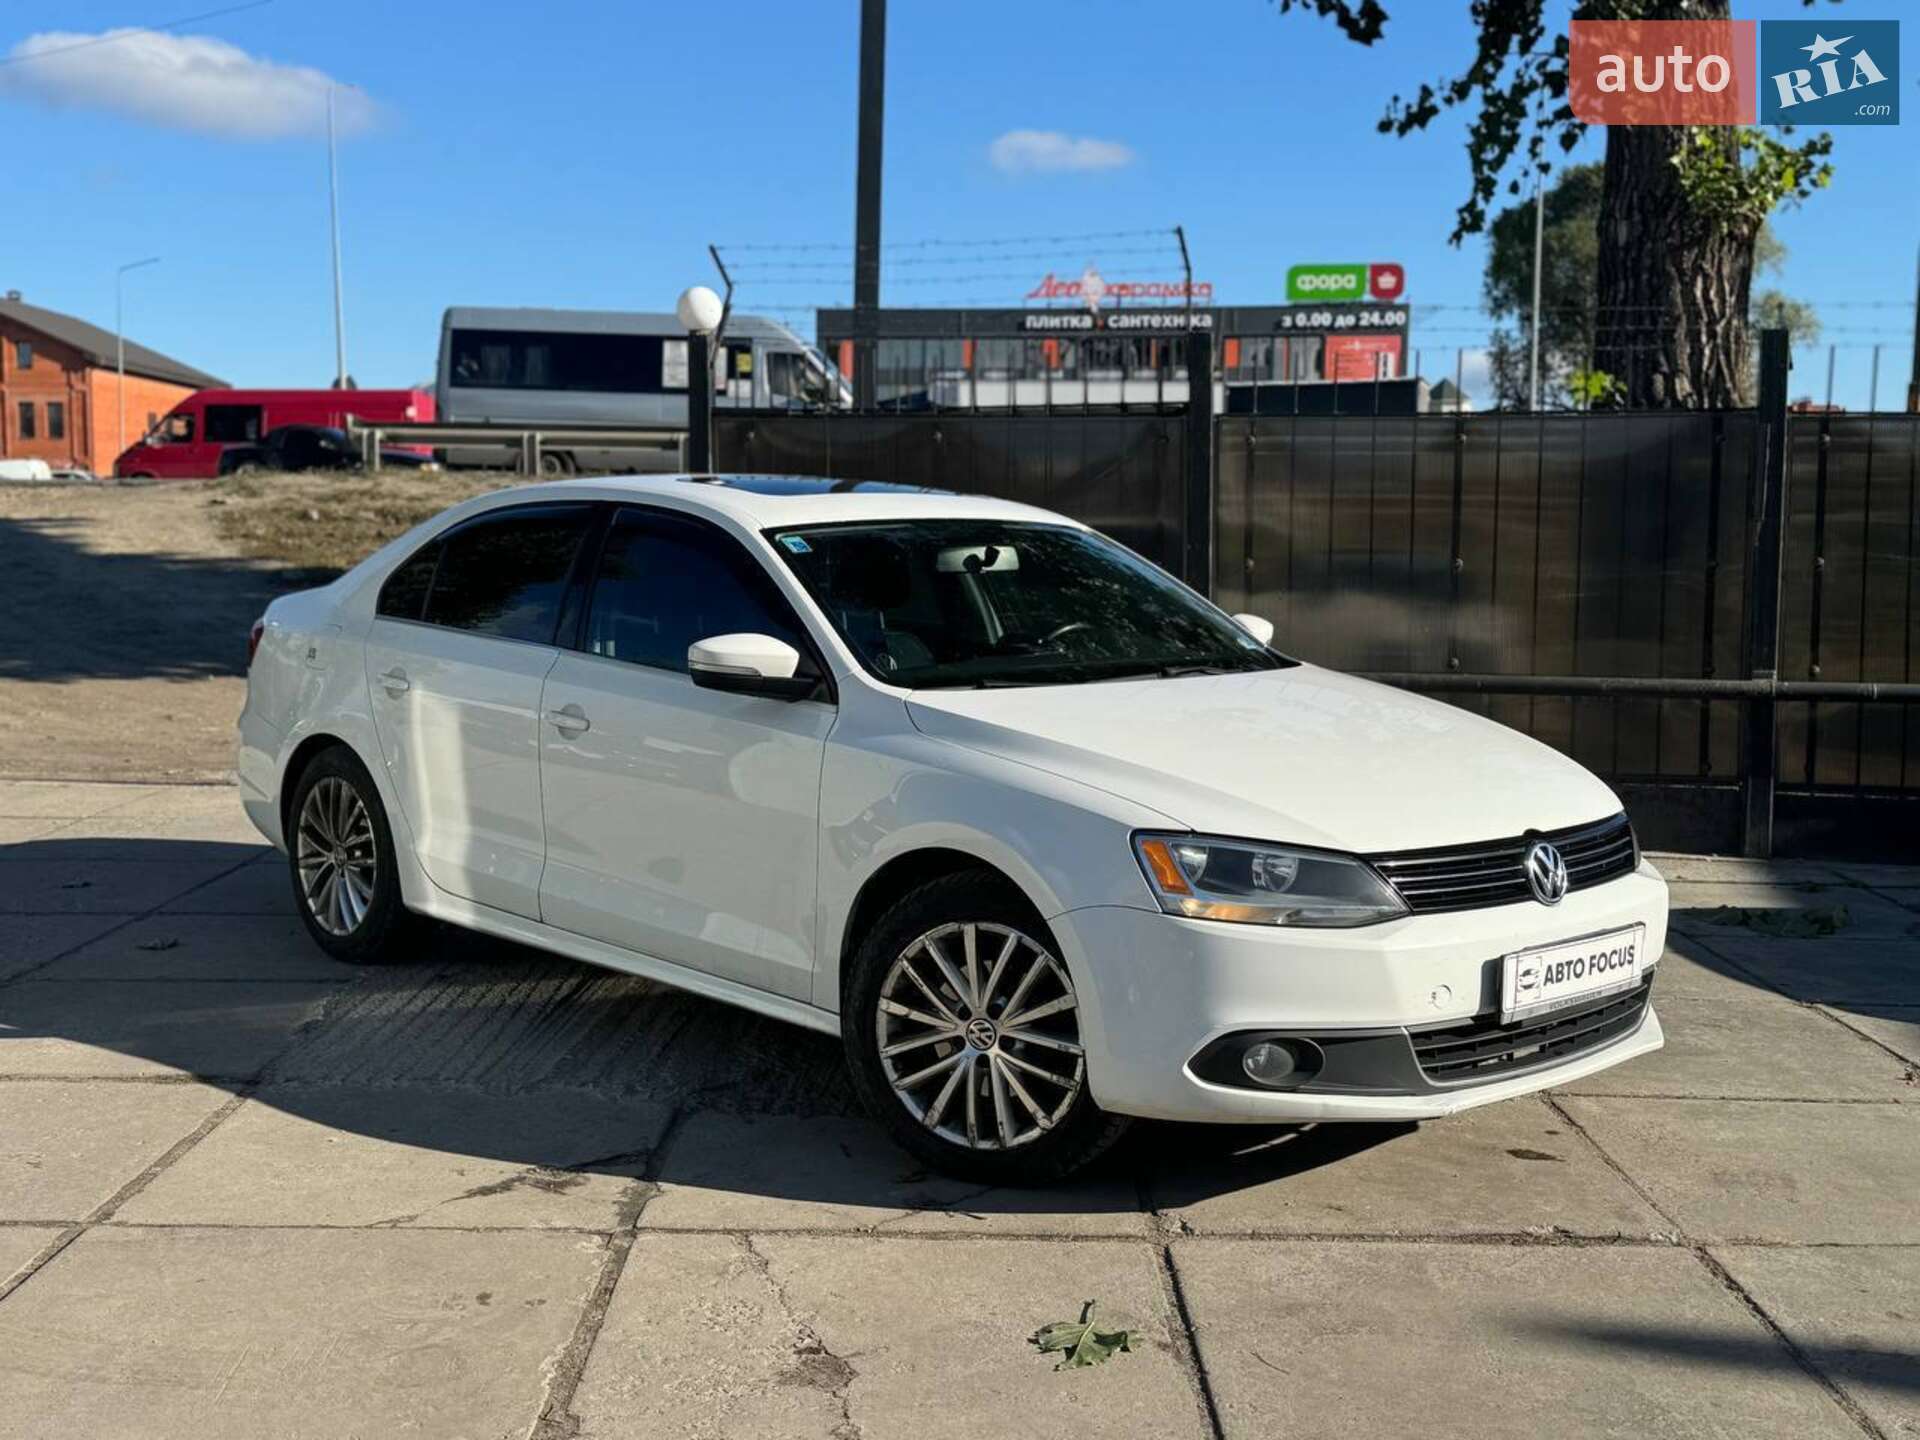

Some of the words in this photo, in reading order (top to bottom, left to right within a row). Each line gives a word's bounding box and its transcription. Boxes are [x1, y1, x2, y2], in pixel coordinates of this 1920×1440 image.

[1296, 274, 1356, 291] фора
[1026, 315, 1093, 328] плитка
[1108, 314, 1212, 328] сантехнка
[1295, 312, 1332, 327] 0.00
[1334, 315, 1356, 328] до
[1359, 311, 1406, 326] 24.00
[1543, 957, 1585, 986] АВТО
[1588, 945, 1635, 975] FOCUS
